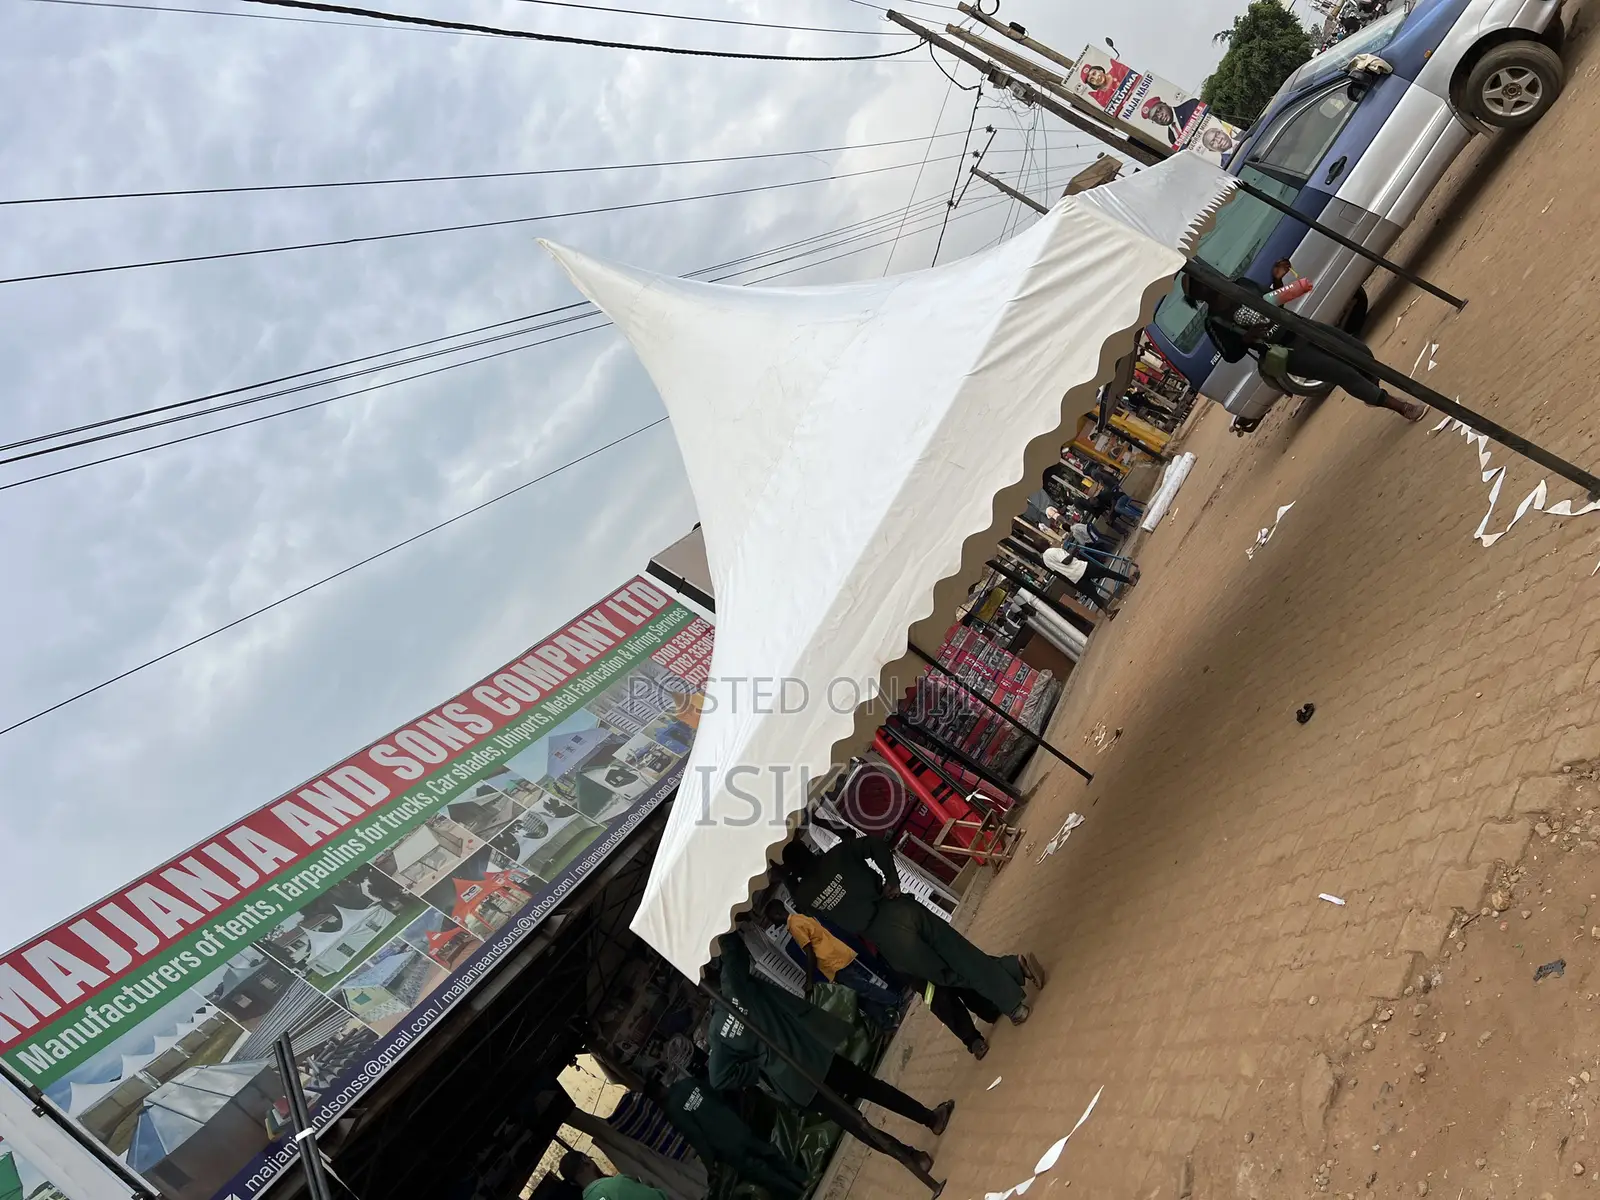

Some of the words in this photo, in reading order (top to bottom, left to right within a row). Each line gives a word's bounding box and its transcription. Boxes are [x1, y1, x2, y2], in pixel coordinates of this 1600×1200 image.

[1105, 73, 1138, 115] NALUYIMA
[1122, 97, 1141, 120] NAJJA
[1136, 74, 1153, 97] NASIIF
[1174, 116, 1195, 146] Chairman
[1189, 130, 1203, 150] GEORGE
[1269, 284, 1294, 296] HEALTH
[652, 644, 681, 665] 0700
[672, 630, 696, 649] 333
[688, 618, 710, 637] 053
[669, 653, 697, 675] 0782
[0, 825, 297, 1043] MAJJANJA
[270, 766, 391, 846] AND
[369, 703, 493, 780] SONS
[472, 609, 627, 716] COMPANY
[605, 581, 668, 626] LTD
[16, 949, 201, 1075] Manufacturers
[195, 929, 218, 957] of
[214, 899, 284, 941] tents,
[267, 834, 366, 902] Tarpaulins
[357, 820, 388, 844] for
[380, 790, 439, 829] trucks,
[425, 771, 458, 796] Car
[451, 743, 506, 779] shades,
[493, 710, 554, 755] Uniports,
[541, 690, 574, 717] Metal
[571, 655, 622, 705] Fabrication
[618, 646, 633, 662] &
[629, 629, 661, 656] Hiring
[648, 608, 688, 636] Services
[441, 876, 574, 1004] majjanjaandsons@yahoo.com
